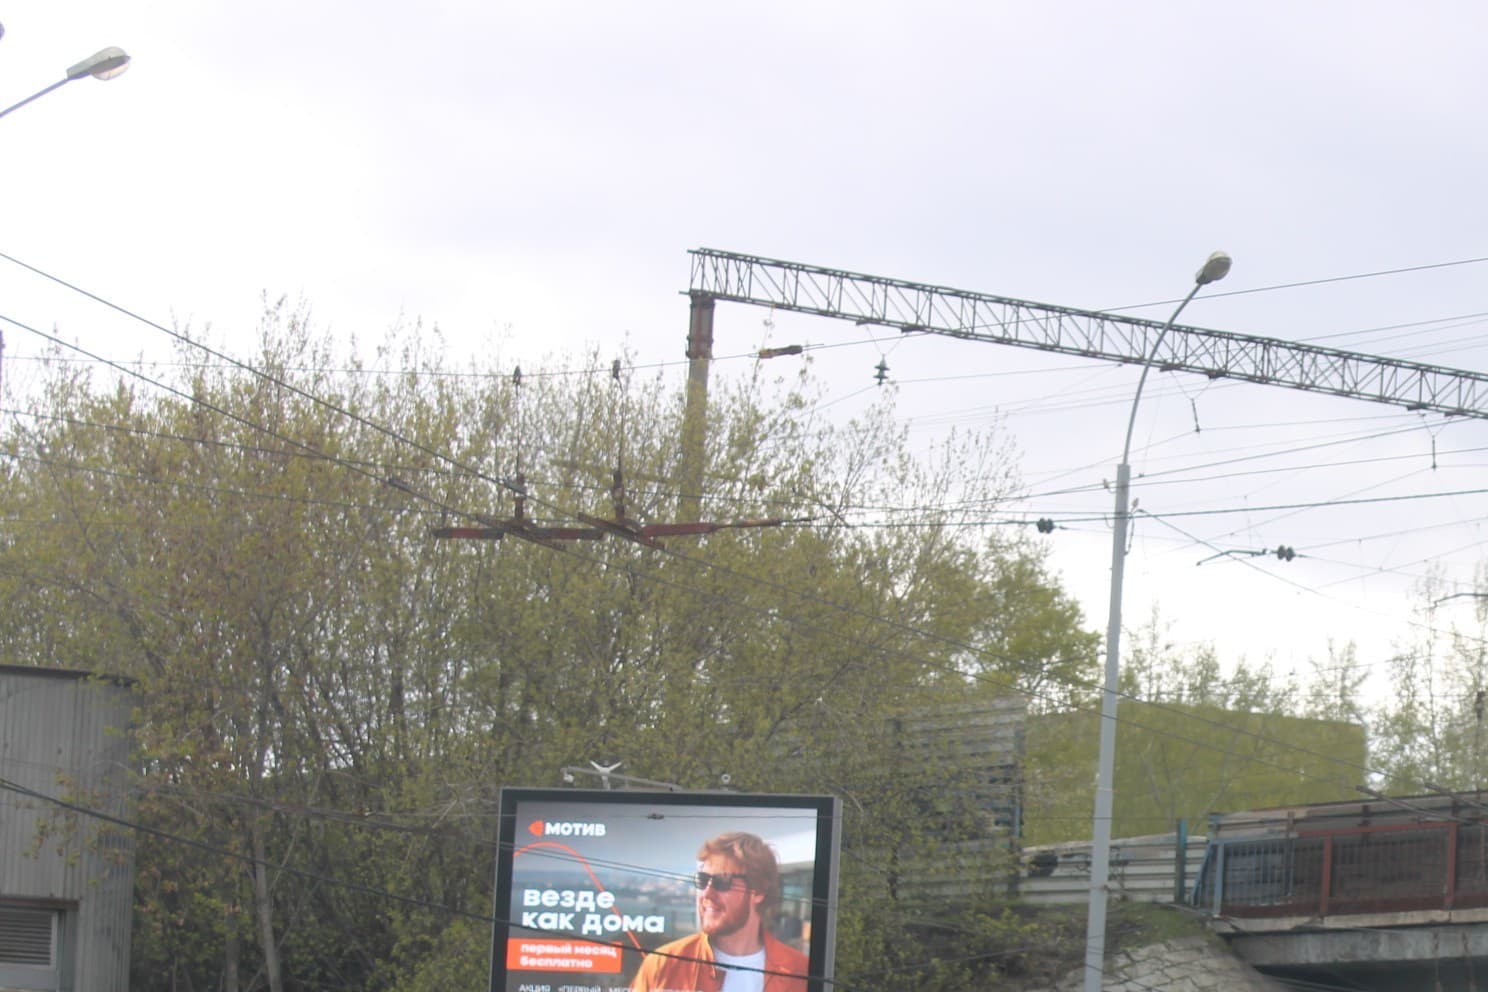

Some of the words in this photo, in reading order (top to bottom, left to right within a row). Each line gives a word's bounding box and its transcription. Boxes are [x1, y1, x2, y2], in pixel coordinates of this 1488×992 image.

[545, 822, 606, 836] МОТИВ
[523, 889, 615, 912] везде
[522, 911, 575, 930] как
[582, 914, 665, 935] дома
[520, 943, 572, 956] первый
[574, 945, 617, 957] месяц
[520, 956, 593, 968] бесплатно
